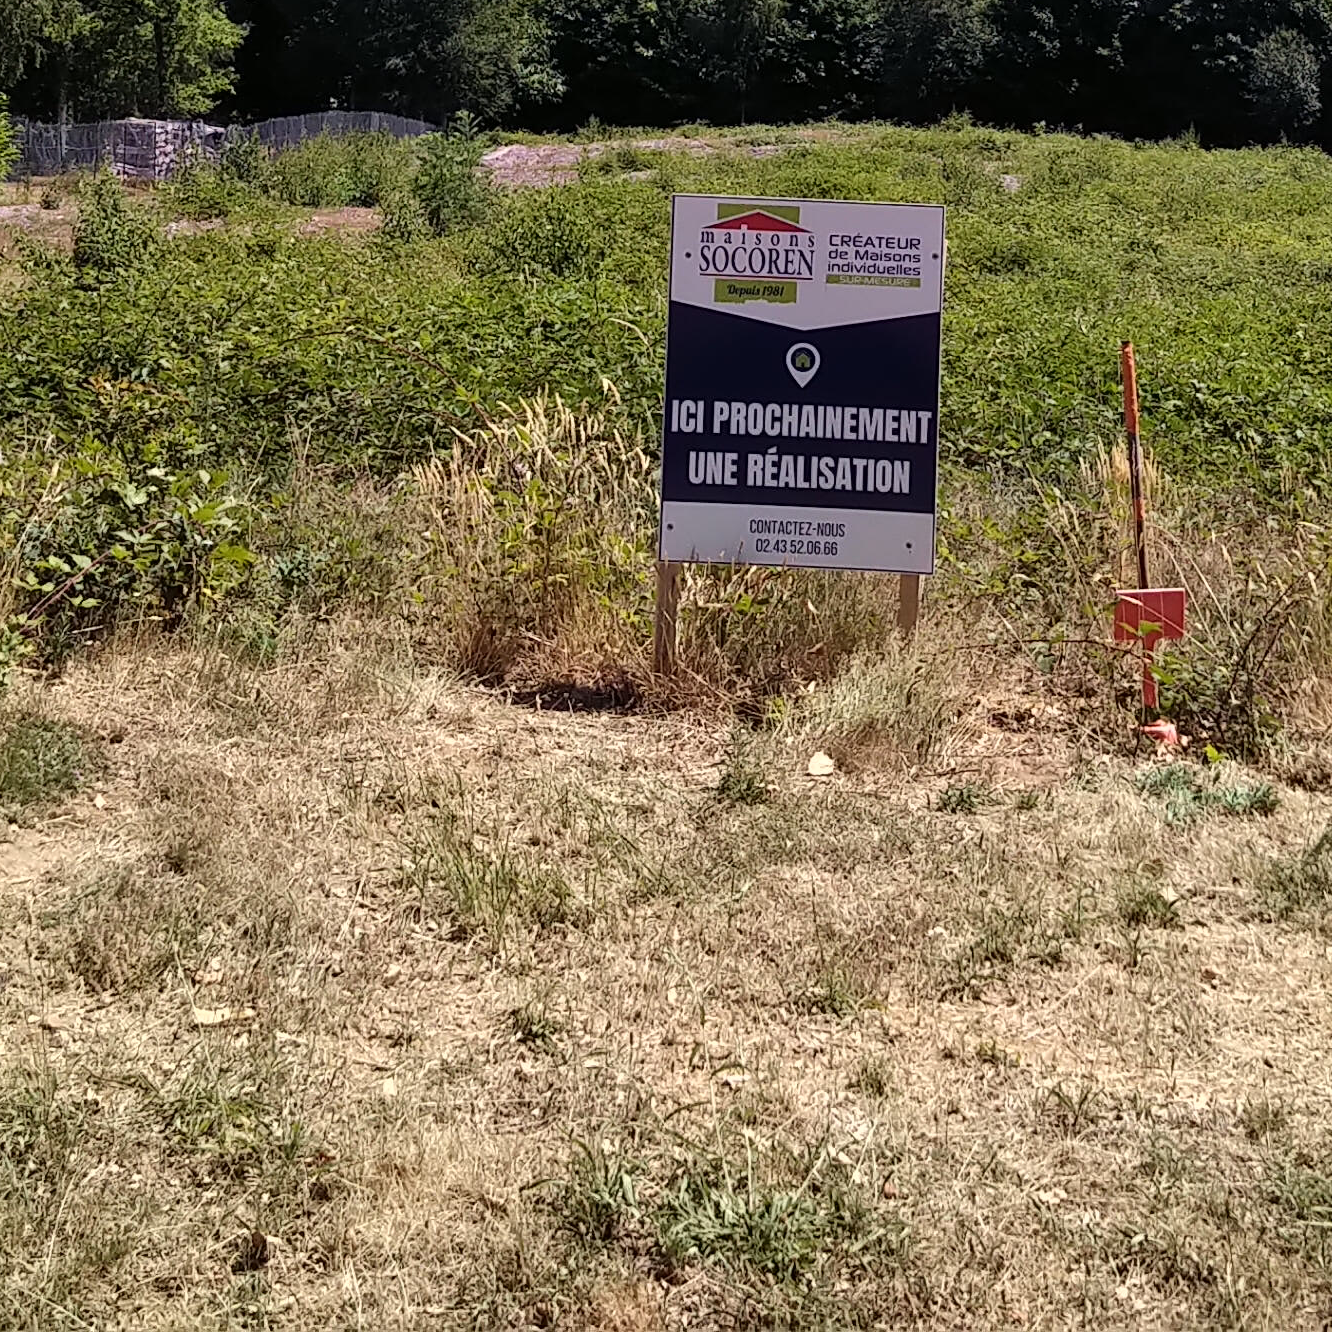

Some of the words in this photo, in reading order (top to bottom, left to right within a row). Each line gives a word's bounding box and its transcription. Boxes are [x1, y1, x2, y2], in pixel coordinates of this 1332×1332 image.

[700, 230, 815, 248] maisons
[829, 233, 921, 250] CRÉATEUR
[699, 245, 815, 276] SOCOREN
[828, 248, 848, 260] de
[854, 250, 921, 263] Maisons
[828, 261, 921, 276] individuelles
[727, 284, 761, 298] Depuis
[762, 285, 785, 297] 1981
[671, 399, 705, 434] ICI
[712, 400, 933, 444] PROCHAINEMENT
[688, 450, 738, 486] UNE
[746, 445, 911, 494] RÉALISATION
[749, 519, 846, 538] CONTACTEZ-NOUS
